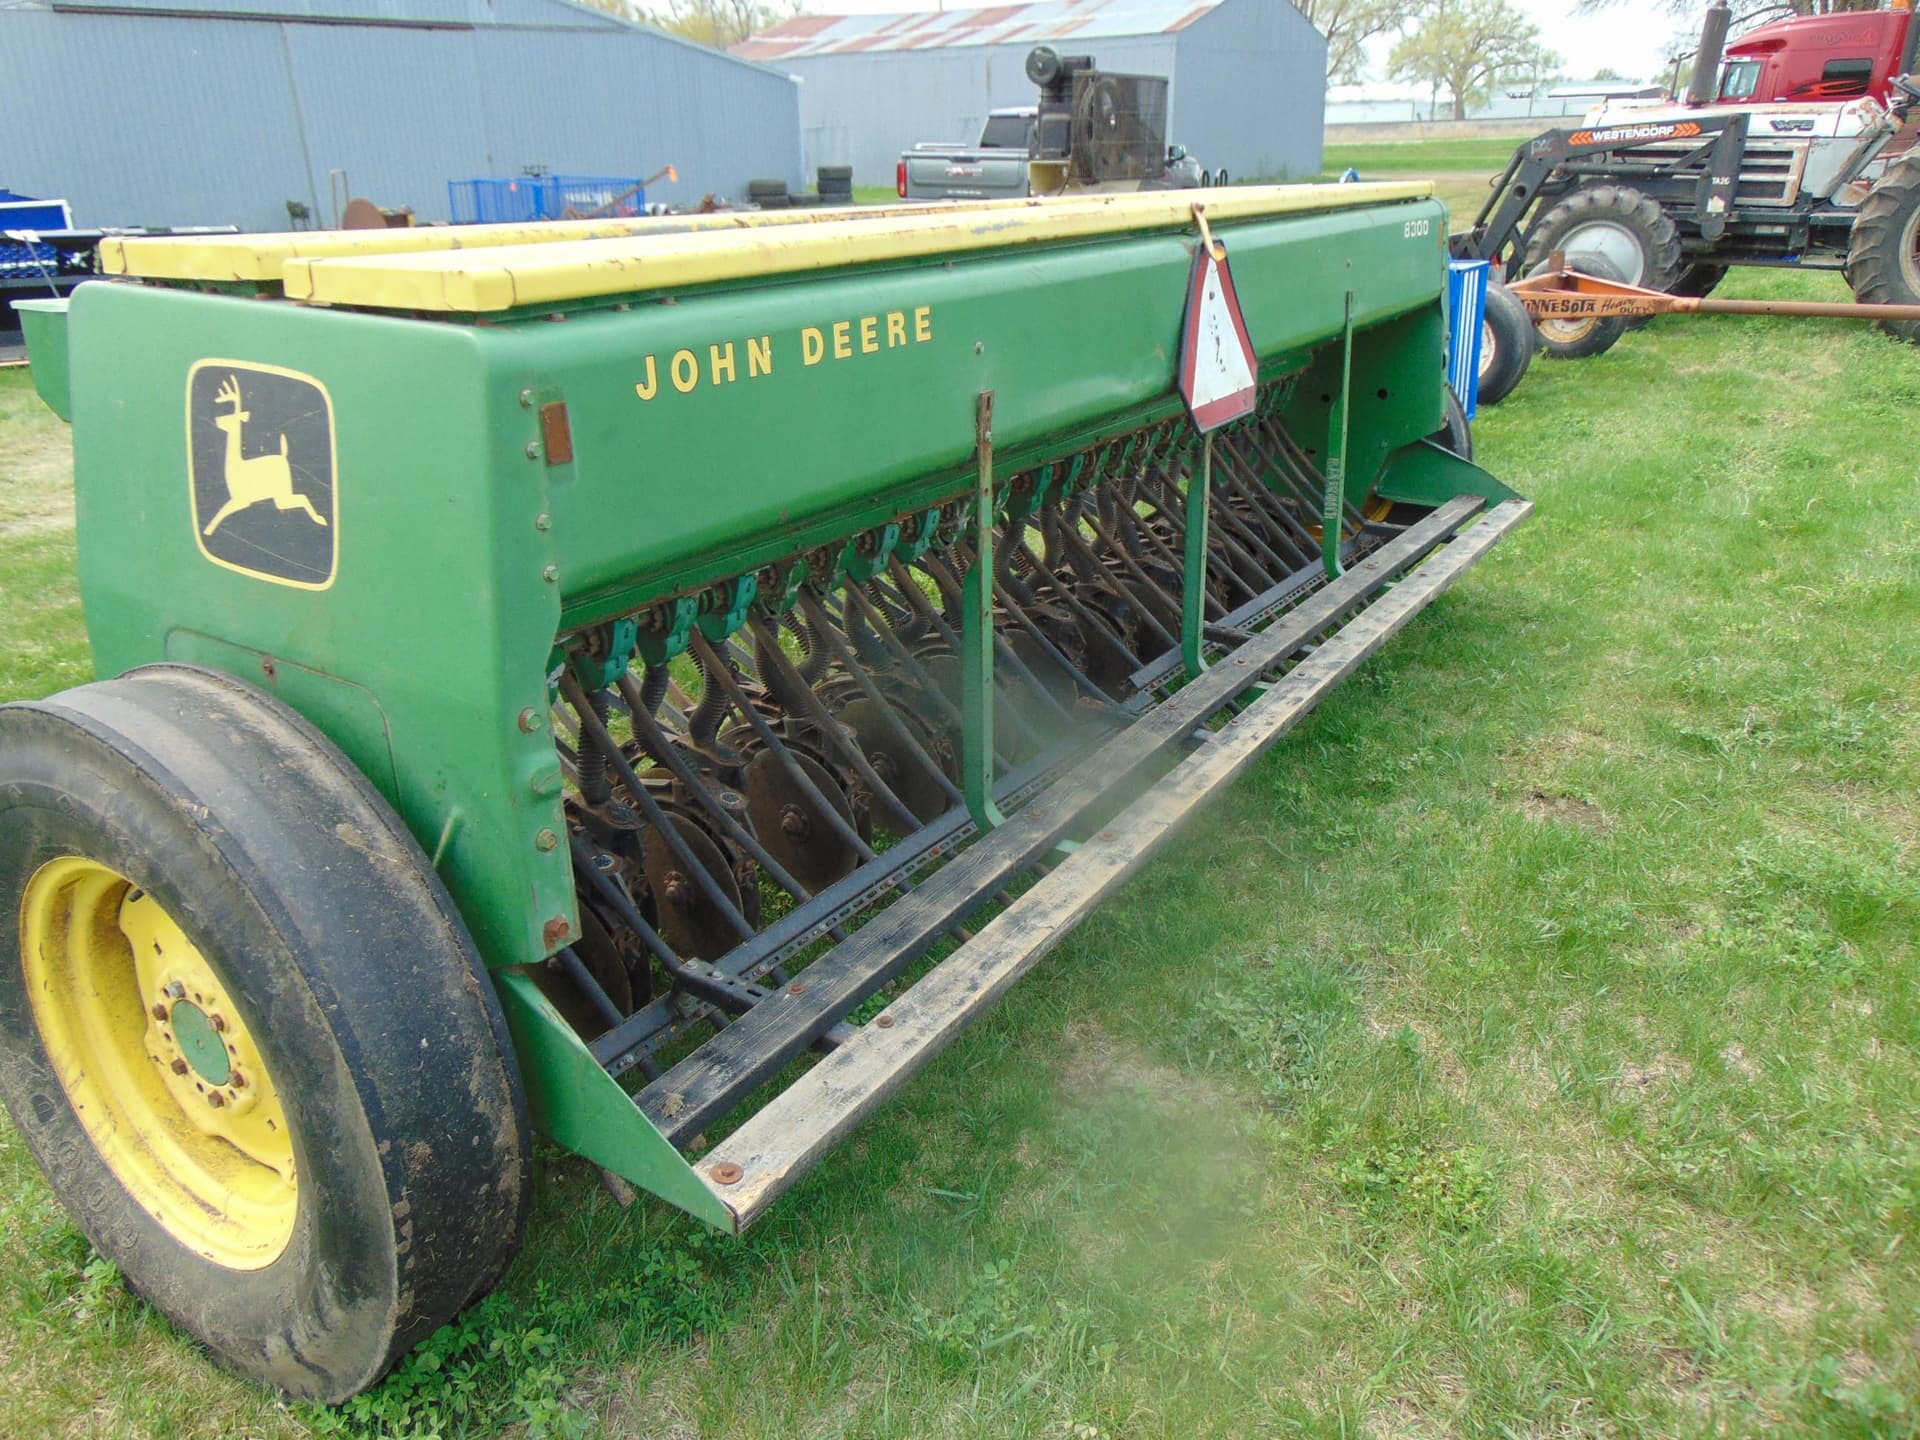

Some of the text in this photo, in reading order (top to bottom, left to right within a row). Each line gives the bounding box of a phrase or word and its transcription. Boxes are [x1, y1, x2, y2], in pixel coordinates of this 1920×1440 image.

[1592, 125, 1675, 141] WESTENDORF
[1404, 219, 1429, 239] 8300
[1520, 299, 1596, 314] INNESOTA
[635, 305, 932, 402] JOHN DEERE
